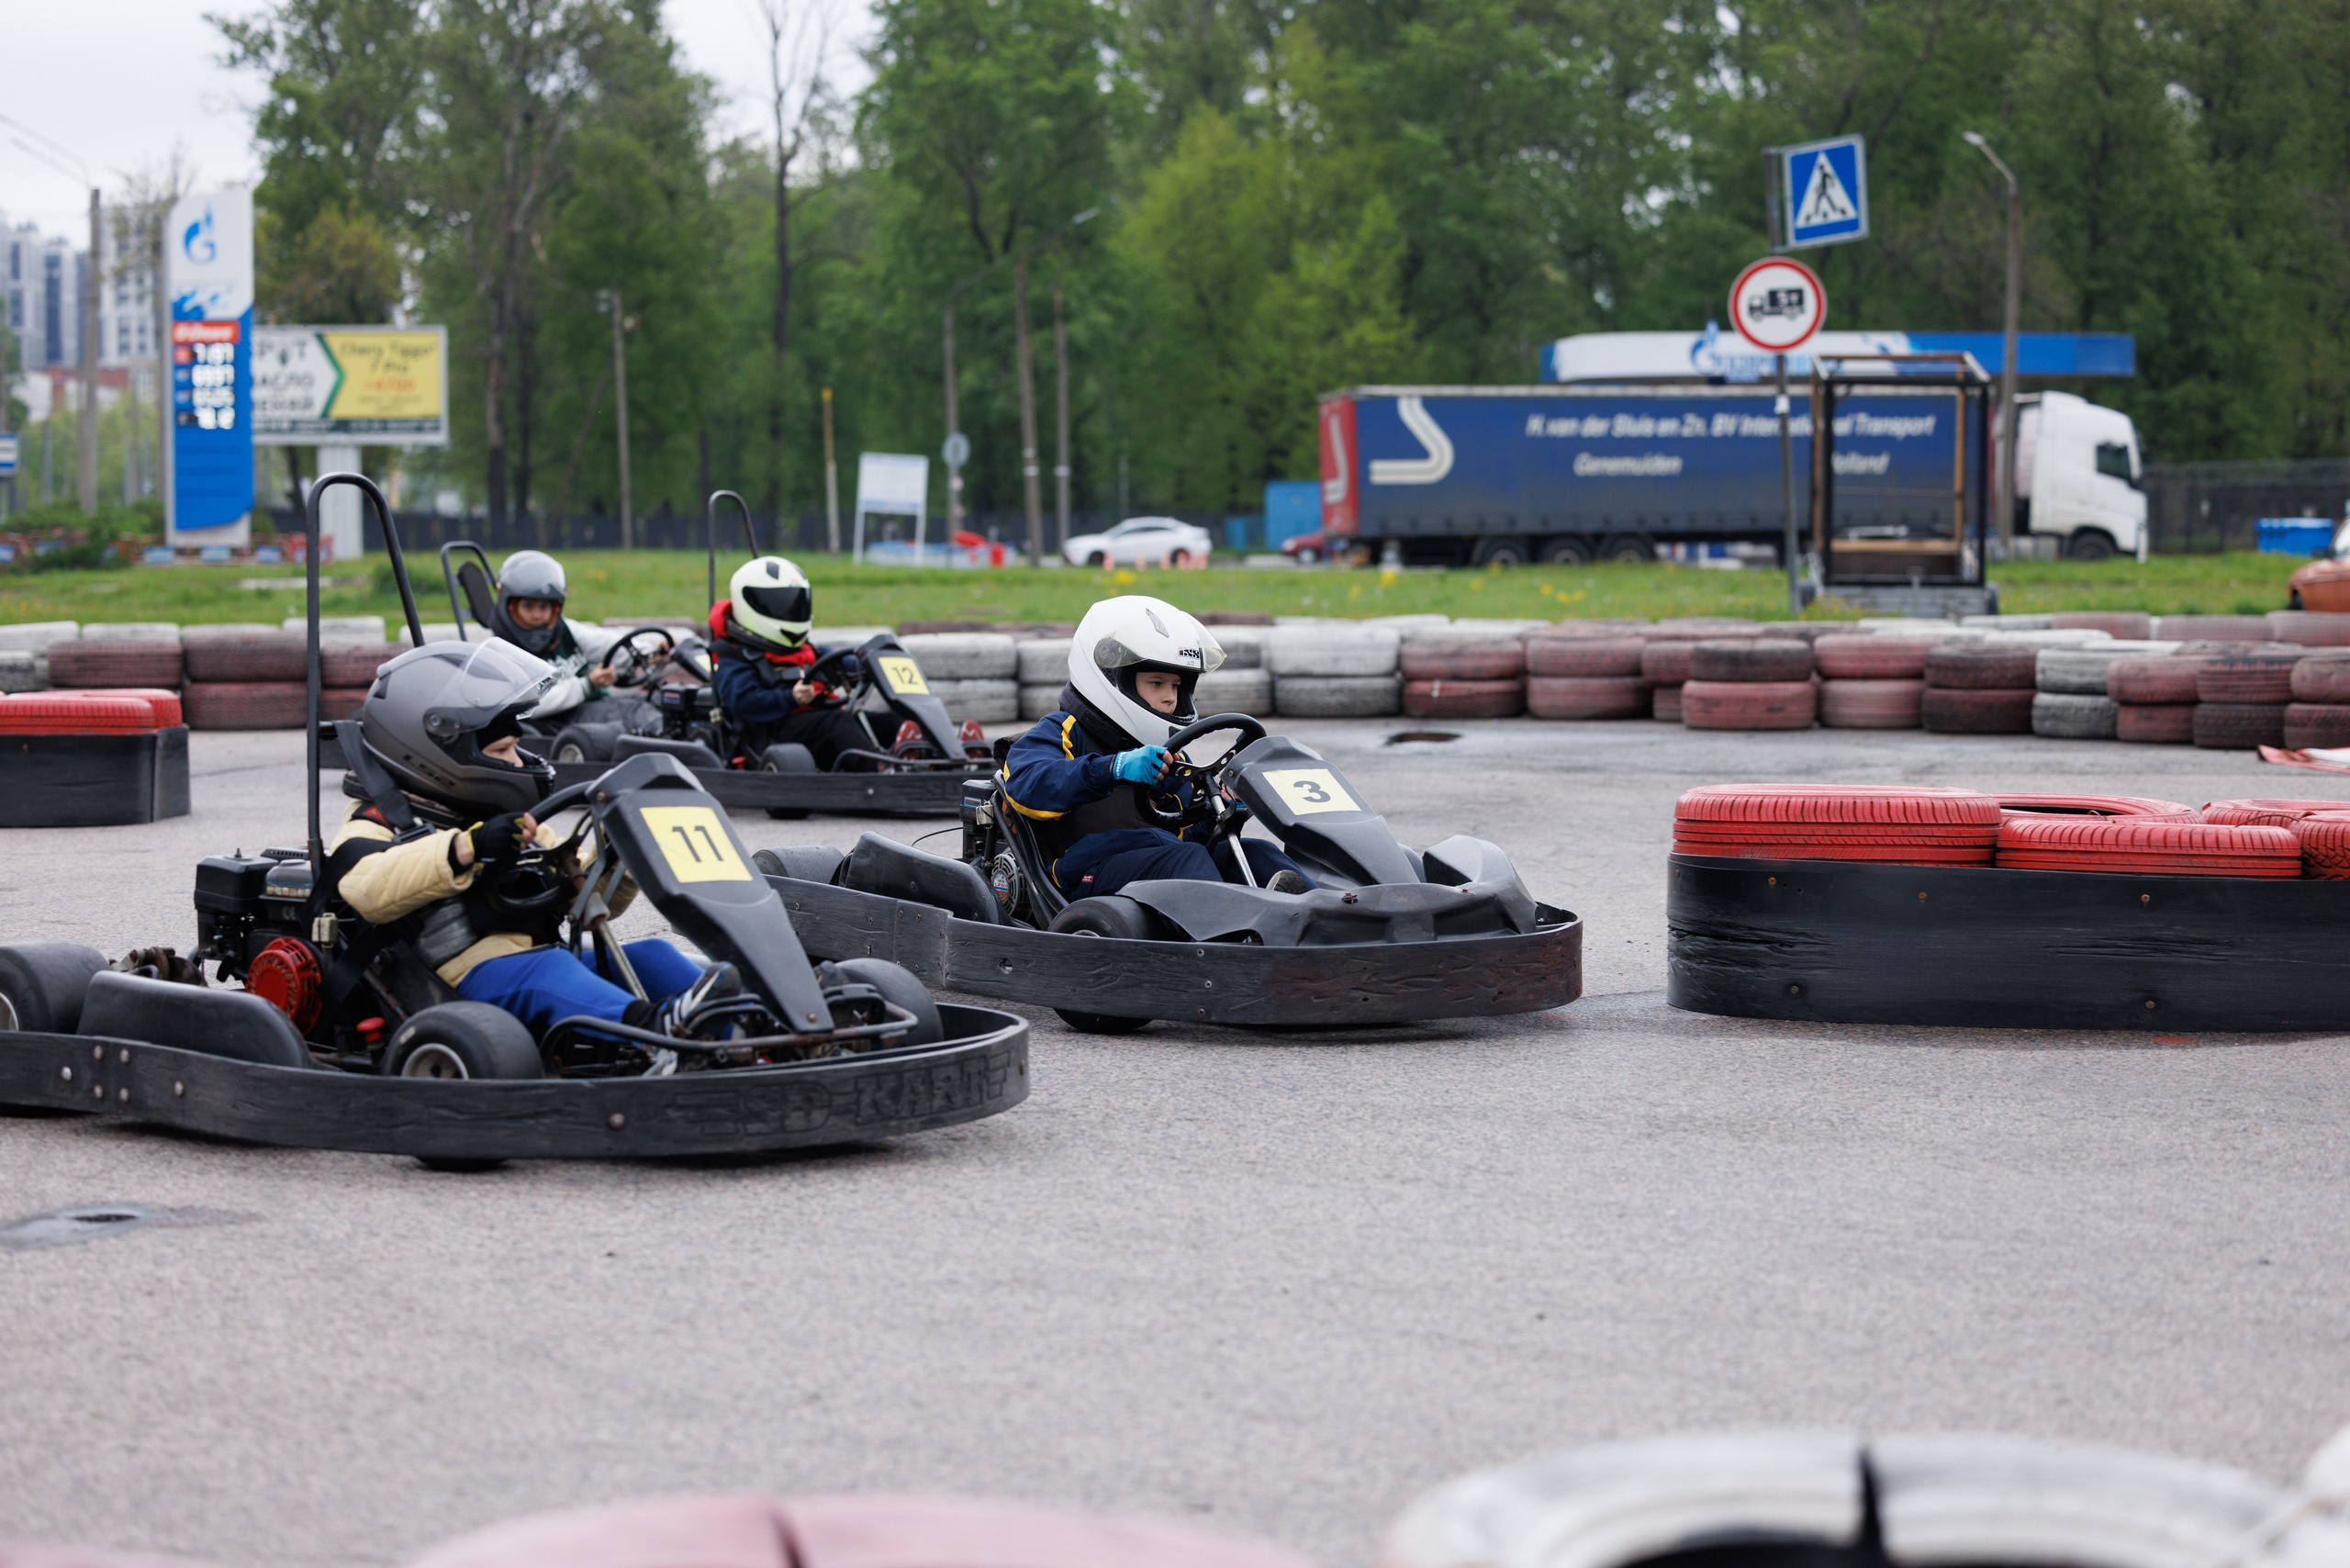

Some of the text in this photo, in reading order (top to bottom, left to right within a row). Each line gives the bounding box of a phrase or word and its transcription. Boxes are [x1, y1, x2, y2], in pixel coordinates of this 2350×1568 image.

[1832, 453, 1890, 475] olland
[892, 666, 918, 685] 12
[1293, 780, 1331, 803] 3
[672, 825, 724, 863] 11
